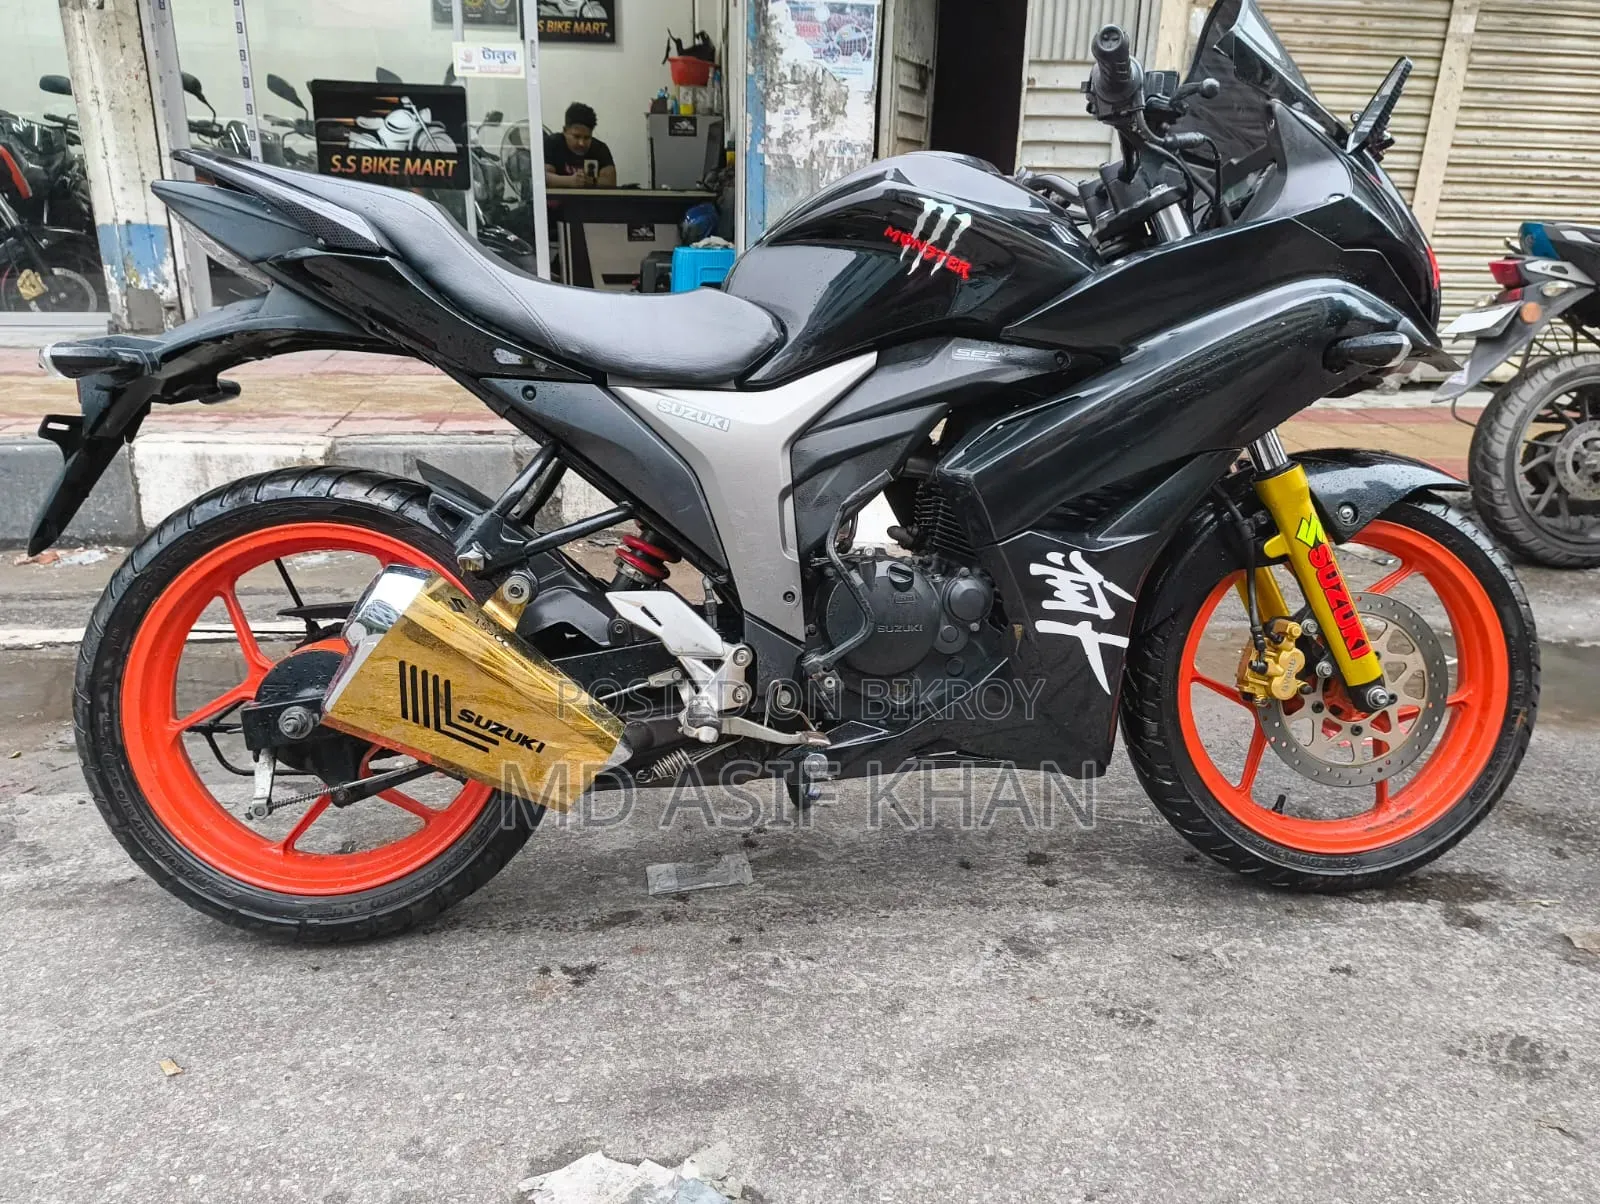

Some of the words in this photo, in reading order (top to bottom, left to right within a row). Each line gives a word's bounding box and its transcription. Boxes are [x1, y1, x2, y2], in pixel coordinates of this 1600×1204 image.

[546, 20, 572, 33] BIKE
[573, 21, 608, 34] MART
[330, 154, 357, 173] S.S
[361, 155, 400, 175] BIKE
[404, 157, 458, 177] MART
[884, 225, 972, 280] MONSTER
[656, 398, 731, 433] SUZUKI
[1308, 543, 1371, 660] SUZUKI
[876, 623, 924, 634] SUZUKI
[457, 708, 547, 754] SUZUKI
